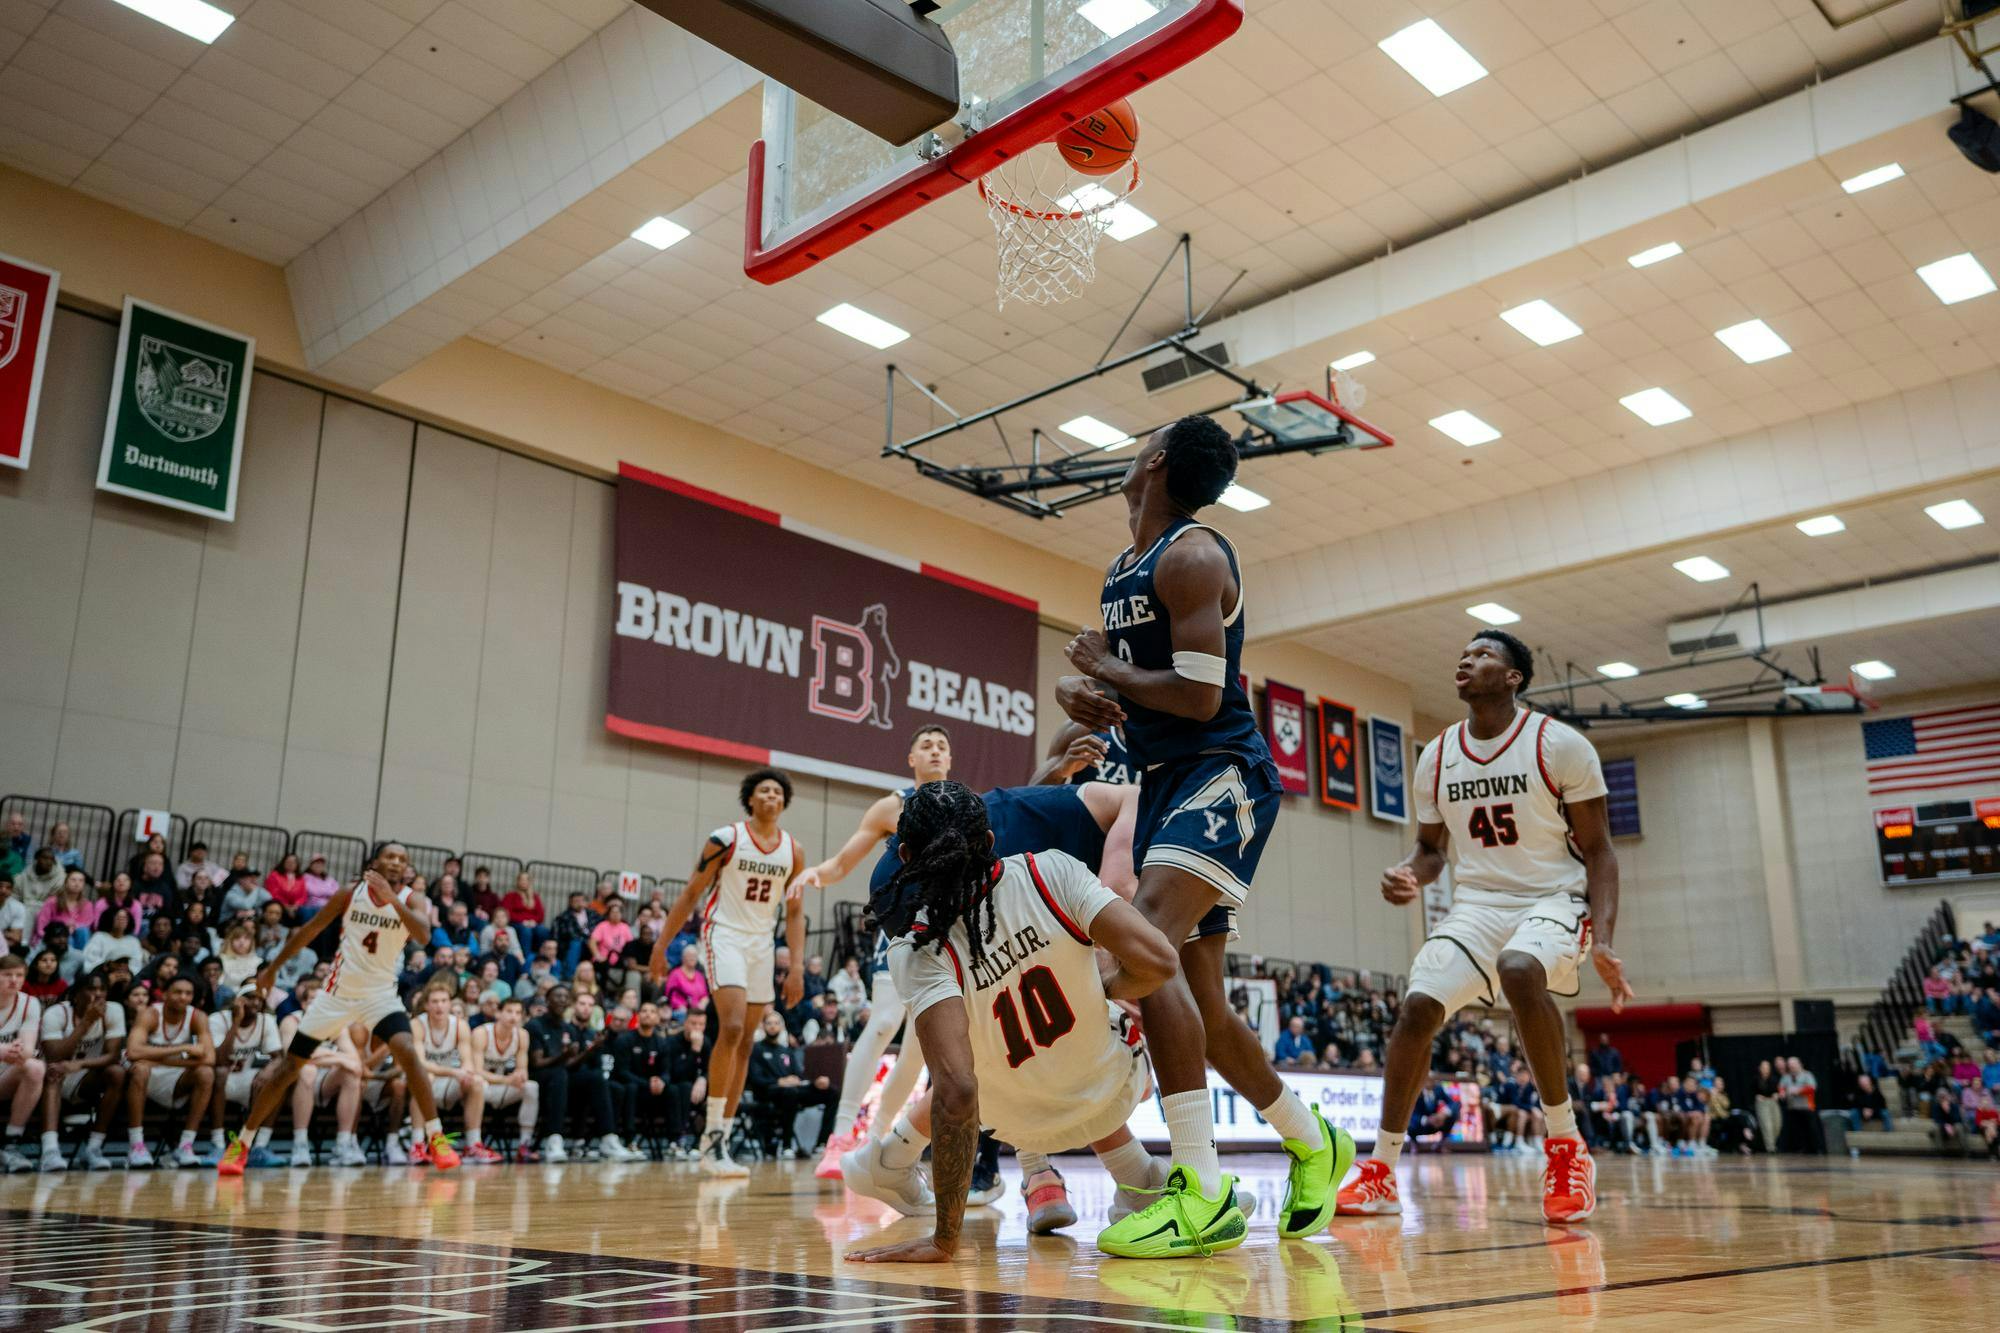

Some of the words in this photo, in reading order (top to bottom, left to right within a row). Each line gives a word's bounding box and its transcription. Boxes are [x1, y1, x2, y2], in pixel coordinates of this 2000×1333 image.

[124, 443, 219, 490] Dartmouth
[1101, 595, 1156, 631] YALE
[616, 581, 803, 678] BROWN
[907, 660, 1035, 737] BEARS
[1447, 773, 1528, 802] BROWN
[1203, 809, 1228, 843] Y
[1468, 803, 1519, 848] 45
[738, 859, 787, 877] BROWN
[622, 875, 638, 894] M
[745, 877, 772, 903] 22
[350, 910, 401, 929] BROWN
[362, 931, 380, 954] 4
[1014, 925, 1050, 960] JR.
[992, 964, 1076, 1069] 10
[1322, 1088, 1358, 1105] Order
